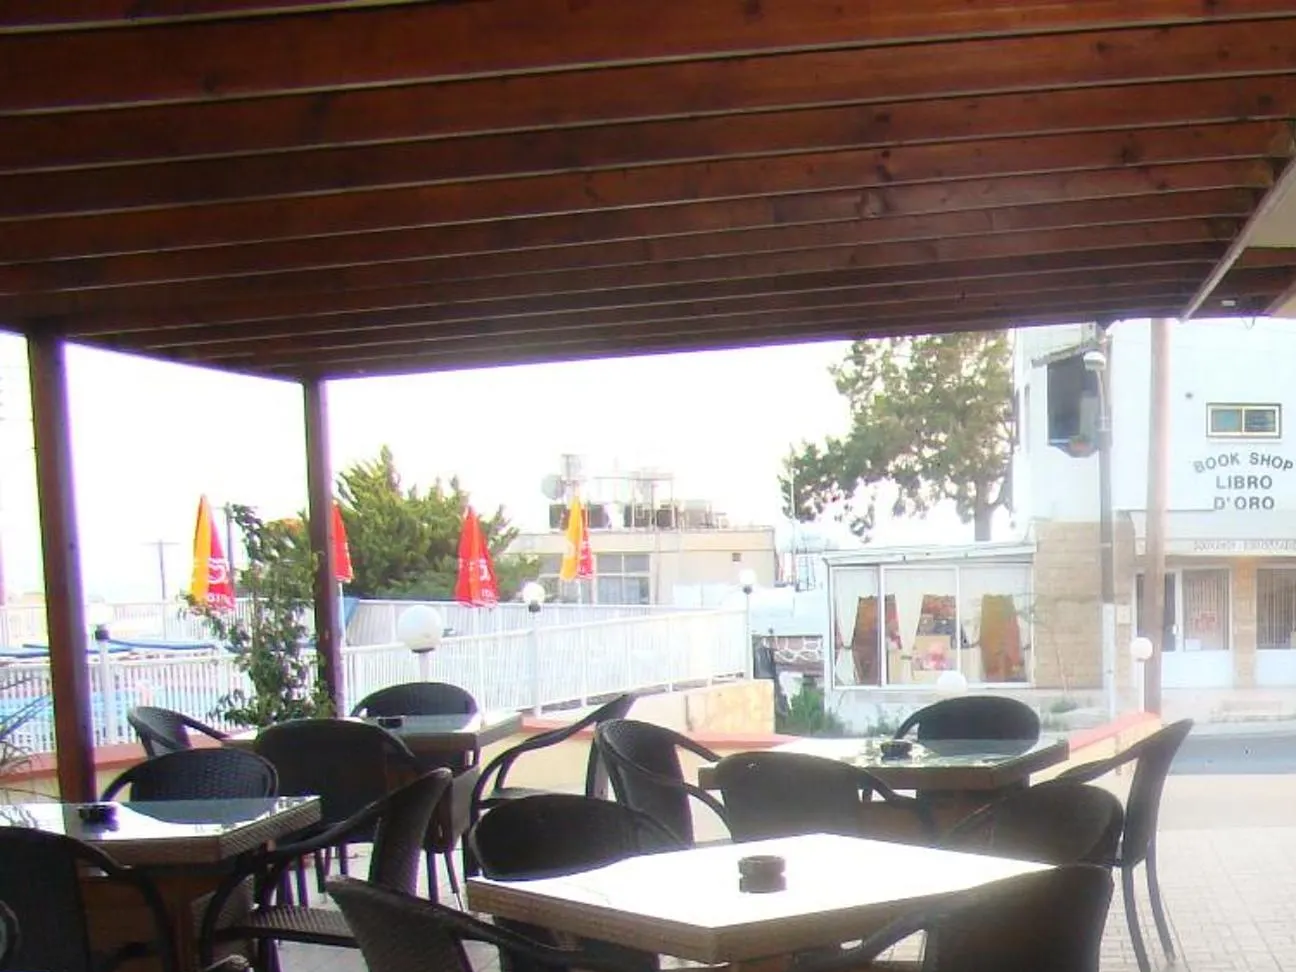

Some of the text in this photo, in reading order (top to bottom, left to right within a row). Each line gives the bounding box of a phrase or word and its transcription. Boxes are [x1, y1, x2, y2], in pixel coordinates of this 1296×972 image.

[1193, 452, 1294, 473] BOOK SHOP
[1216, 475, 1273, 489] LIBRO
[1213, 496, 1275, 510] D'ORO
